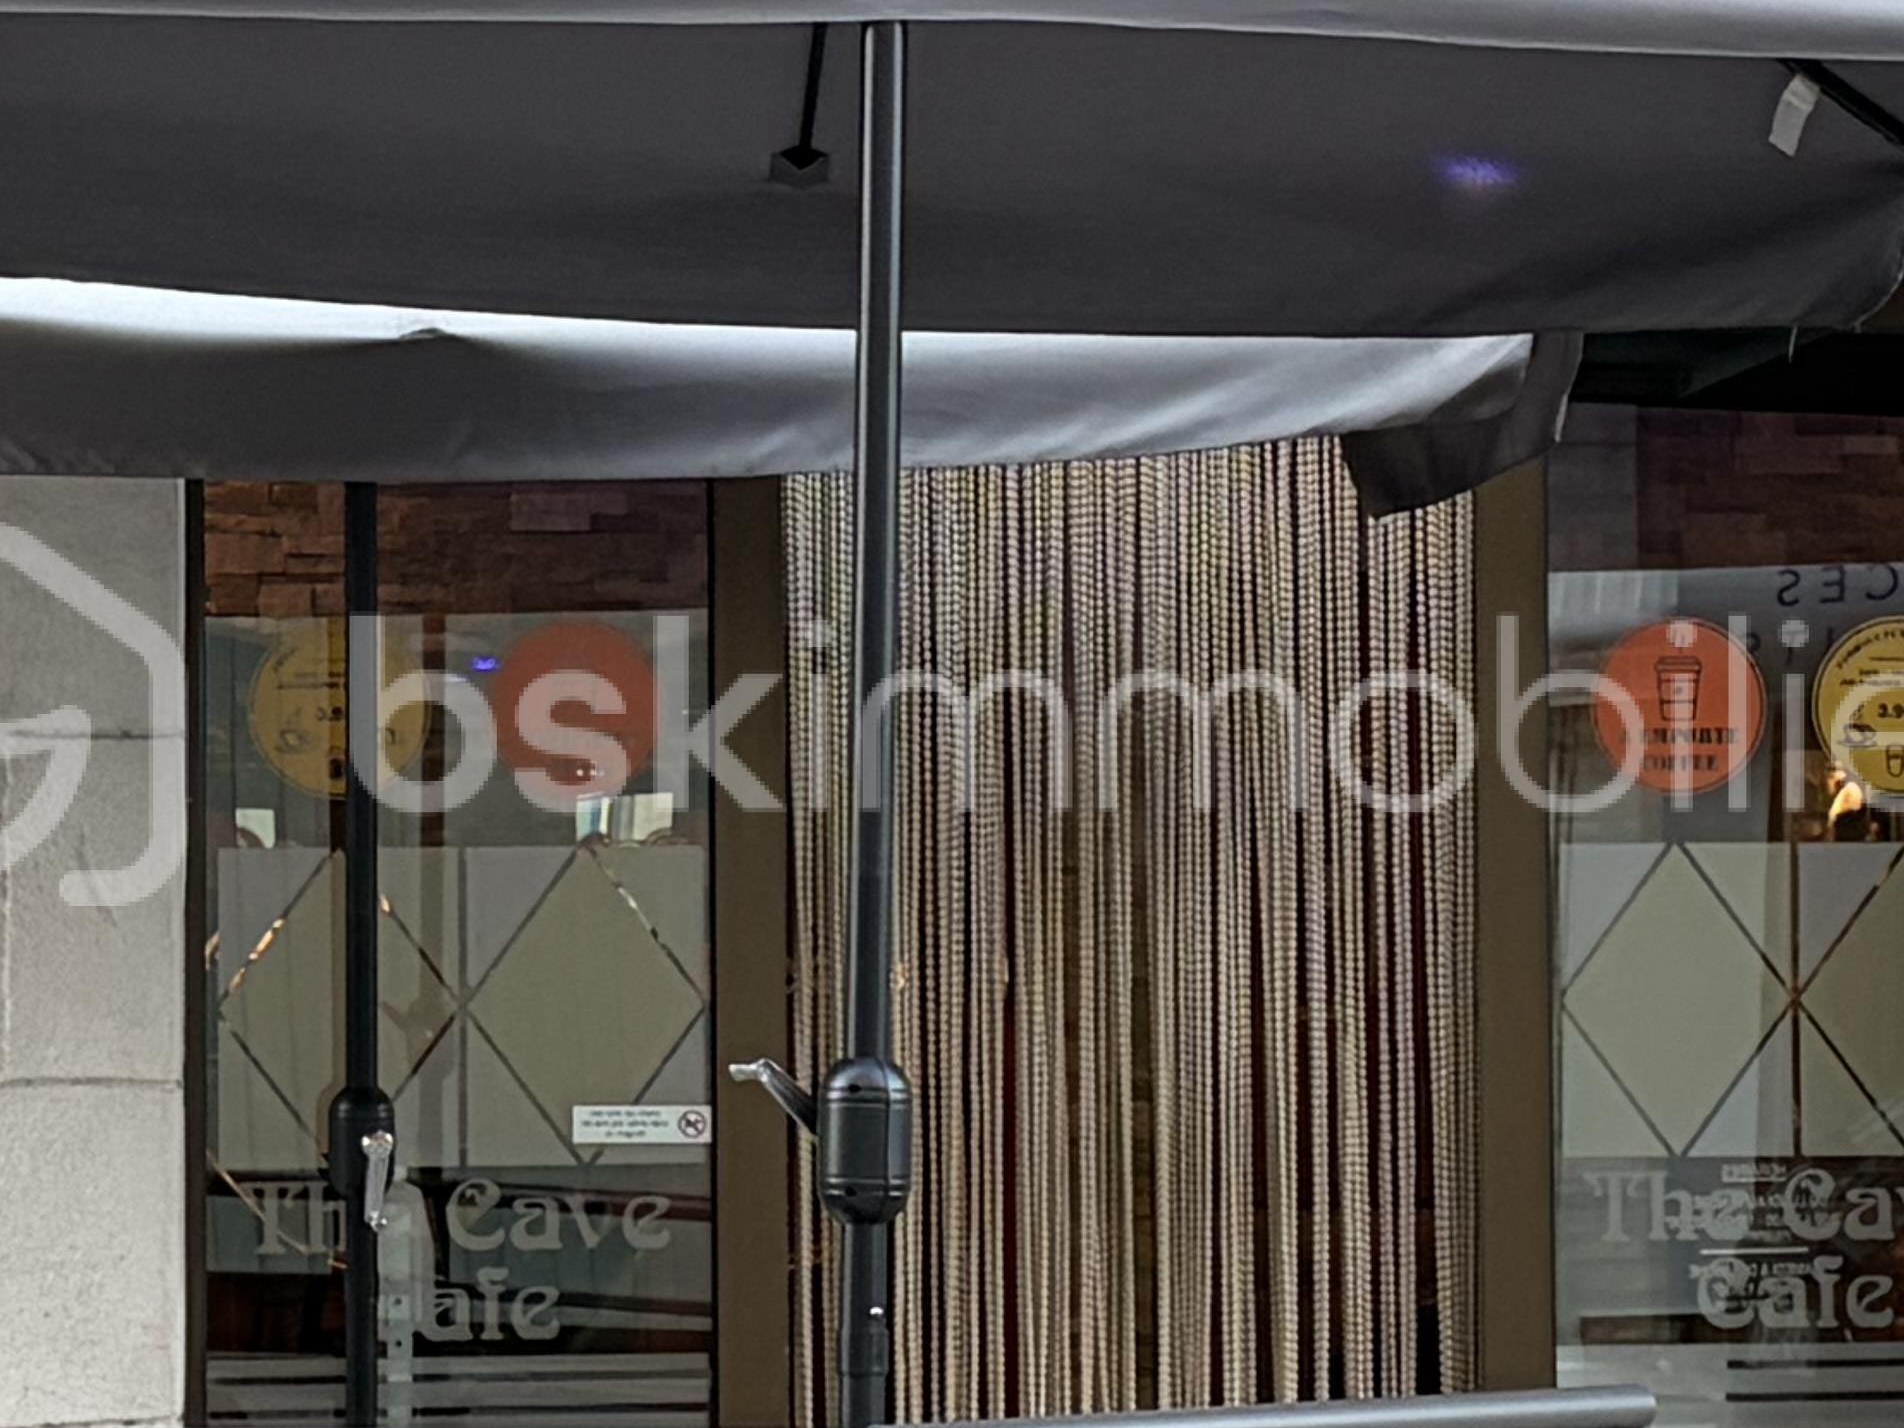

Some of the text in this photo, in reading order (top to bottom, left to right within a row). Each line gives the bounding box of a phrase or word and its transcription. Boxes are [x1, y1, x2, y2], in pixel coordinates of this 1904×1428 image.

[242, 1176, 672, 1254] Th Cave
[416, 1265, 561, 1342] afe
[1696, 1255, 1895, 1329] Cafe
